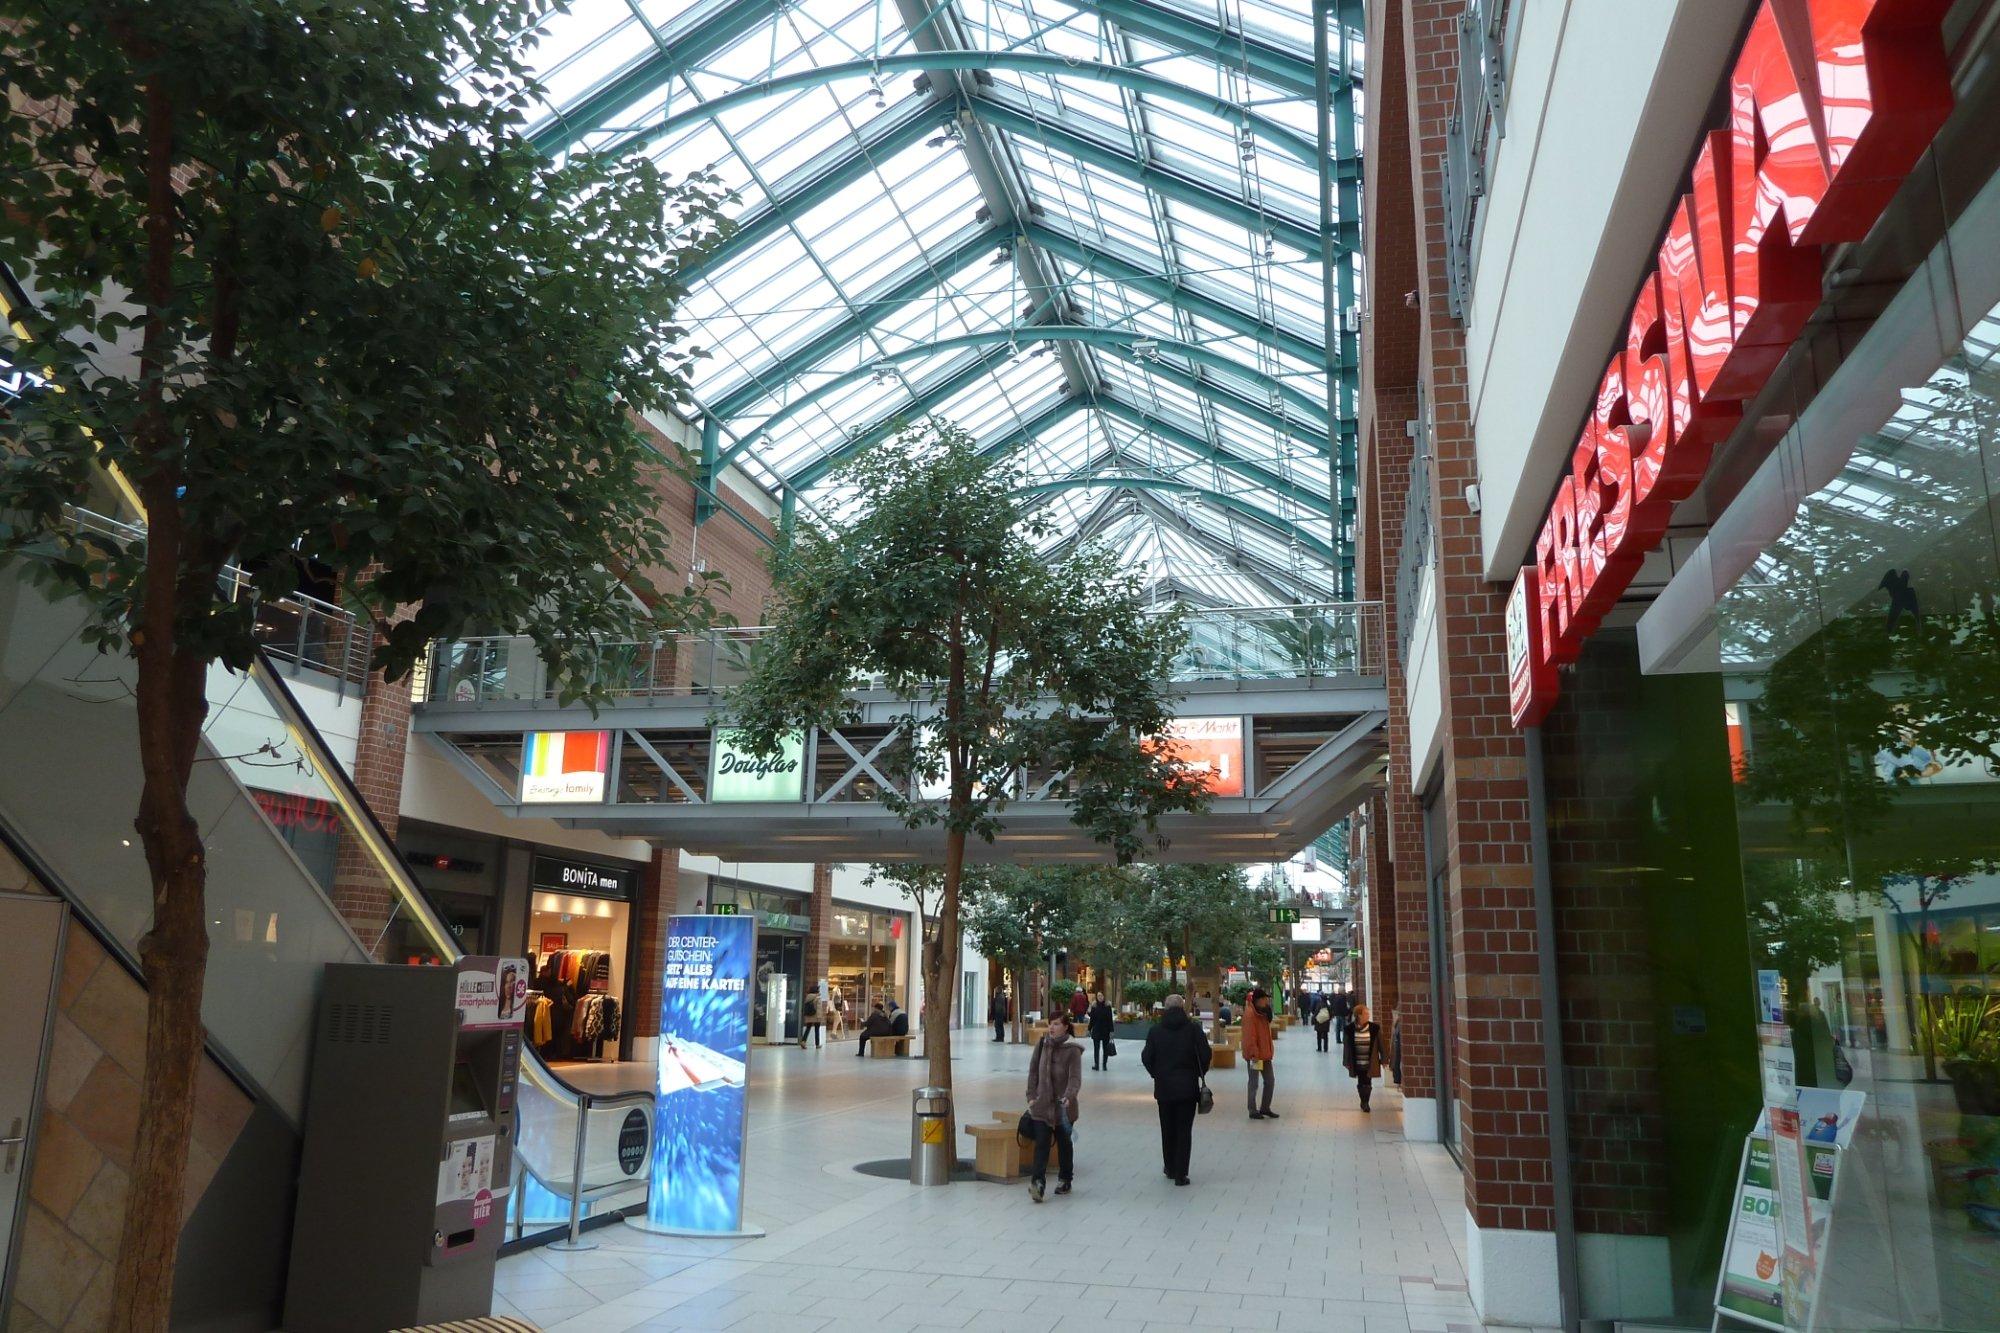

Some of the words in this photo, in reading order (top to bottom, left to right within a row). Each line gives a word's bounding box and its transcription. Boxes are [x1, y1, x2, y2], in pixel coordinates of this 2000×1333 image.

[718, 752, 799, 780] Douglas
[564, 783, 594, 796] family
[600, 877, 618, 890] men
[668, 937, 679, 948] DER
[681, 936, 719, 948] CENTER-
[683, 964, 713, 976] ALLES
[678, 978, 699, 989] EINE
[702, 979, 745, 990] KARTE!
[459, 996, 498, 1009] smartphone
